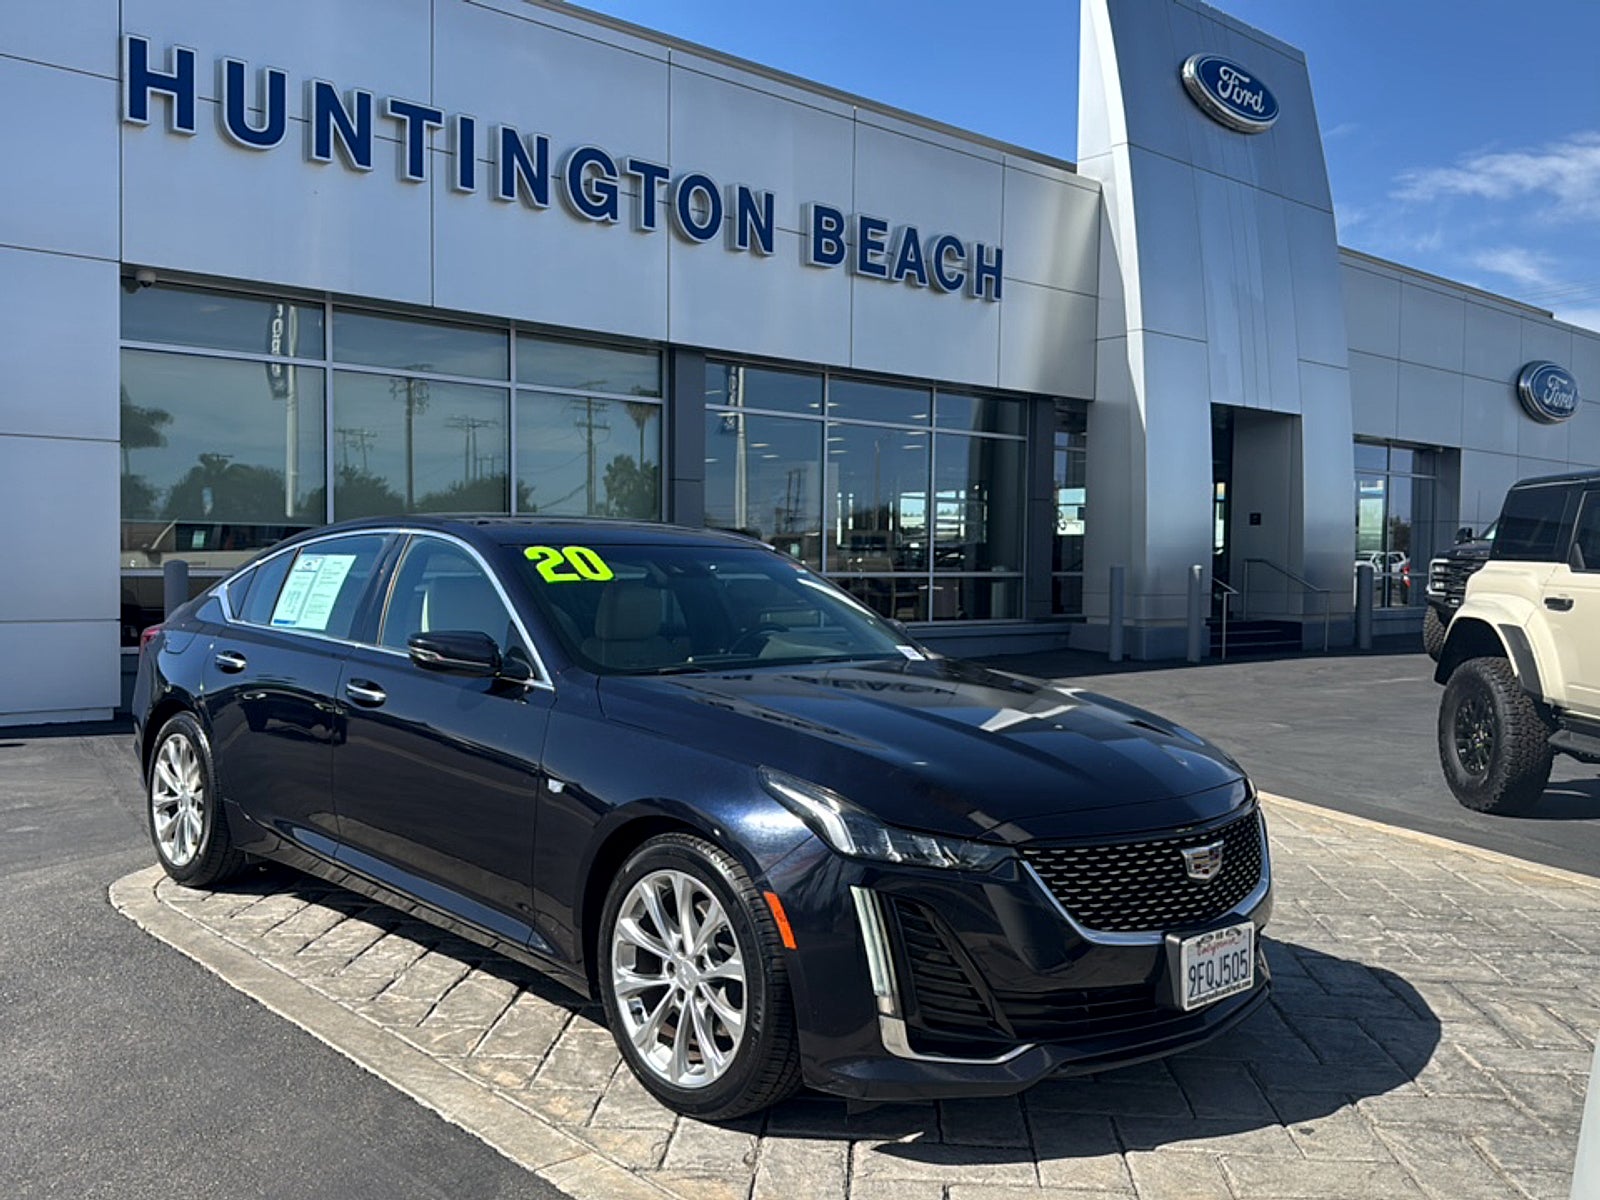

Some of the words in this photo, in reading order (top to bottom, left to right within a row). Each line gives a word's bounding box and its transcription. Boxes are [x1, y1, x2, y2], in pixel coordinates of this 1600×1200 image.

[1217, 66, 1264, 113] Ford
[123, 35, 775, 256] HUNTINGTON
[809, 203, 1003, 301] BEACH
[1543, 374, 1575, 410] Ford
[523, 546, 615, 584] 20
[1188, 949, 1248, 997] 9FQJ505
